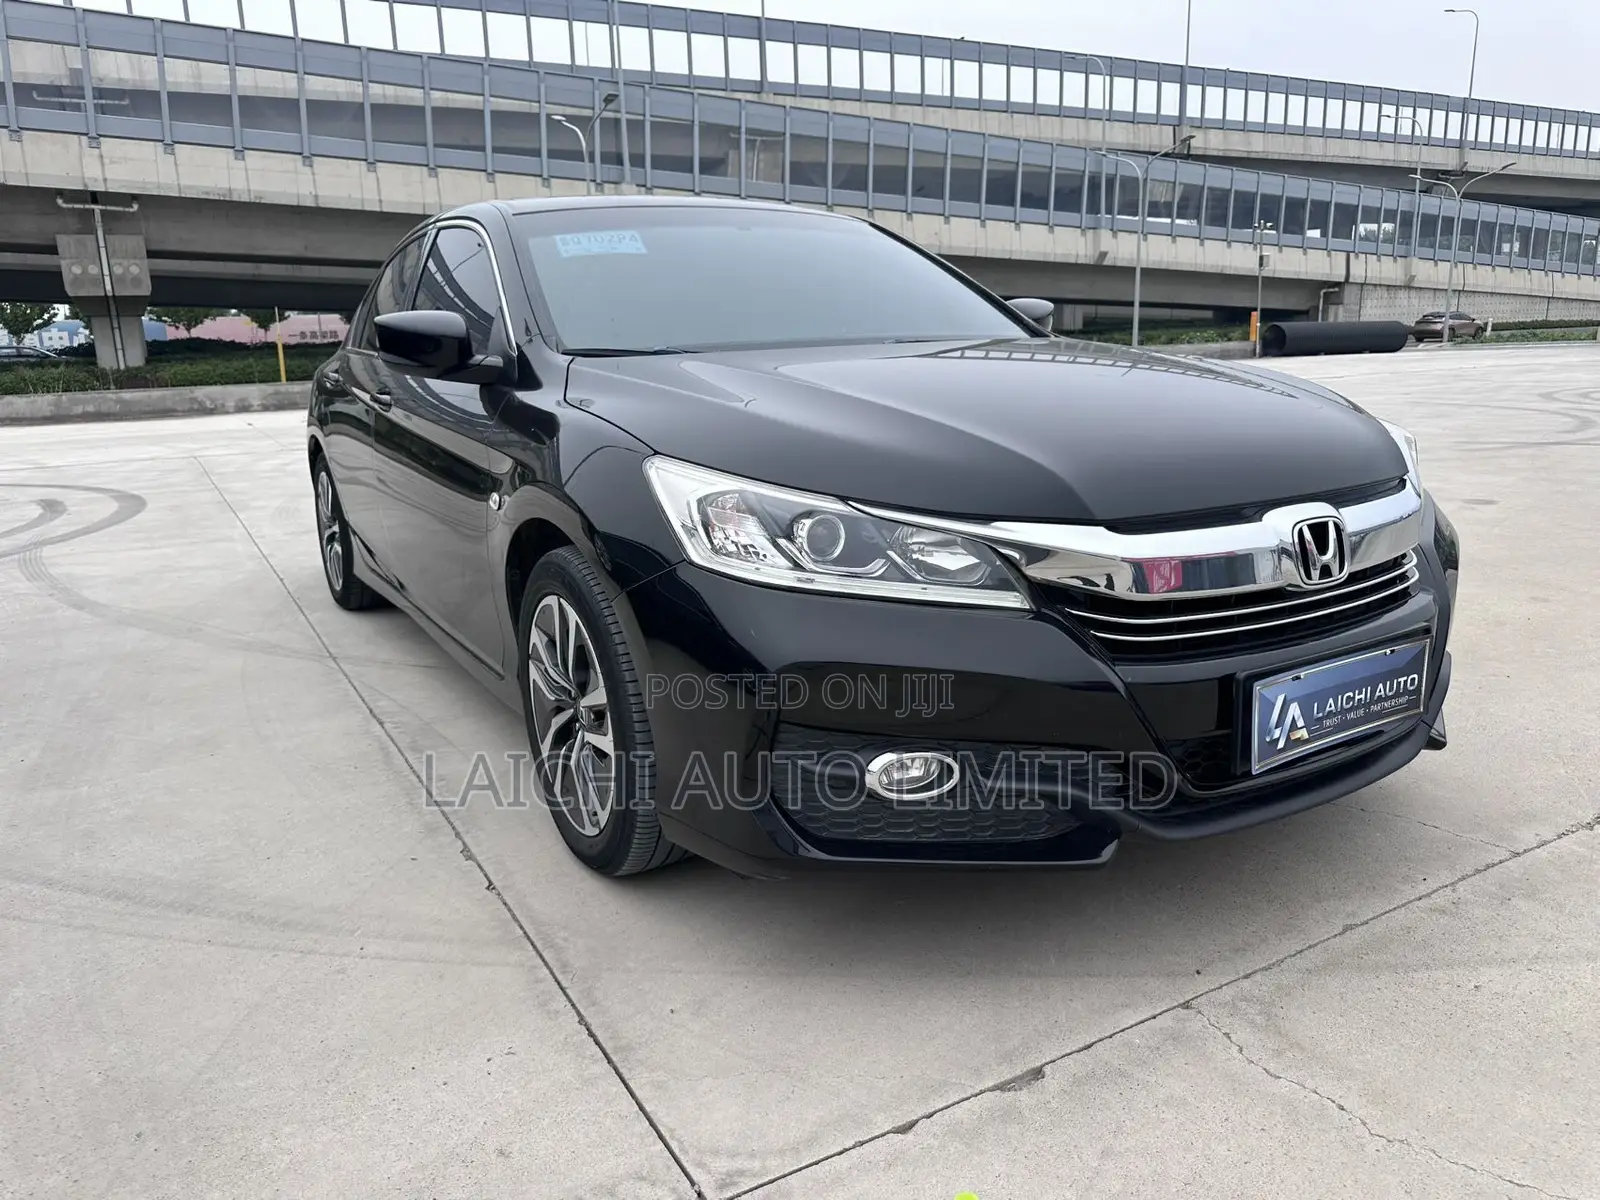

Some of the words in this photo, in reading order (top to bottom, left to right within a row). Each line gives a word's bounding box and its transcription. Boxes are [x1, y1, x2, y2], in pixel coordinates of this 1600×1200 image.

[1313, 686, 1371, 719] LAICHI
[1374, 673, 1419, 701] AUTO
[1322, 715, 1341, 728] TRUST
[1346, 708, 1365, 720] VALUE
[1370, 695, 1409, 713] PARTNERSHIP
